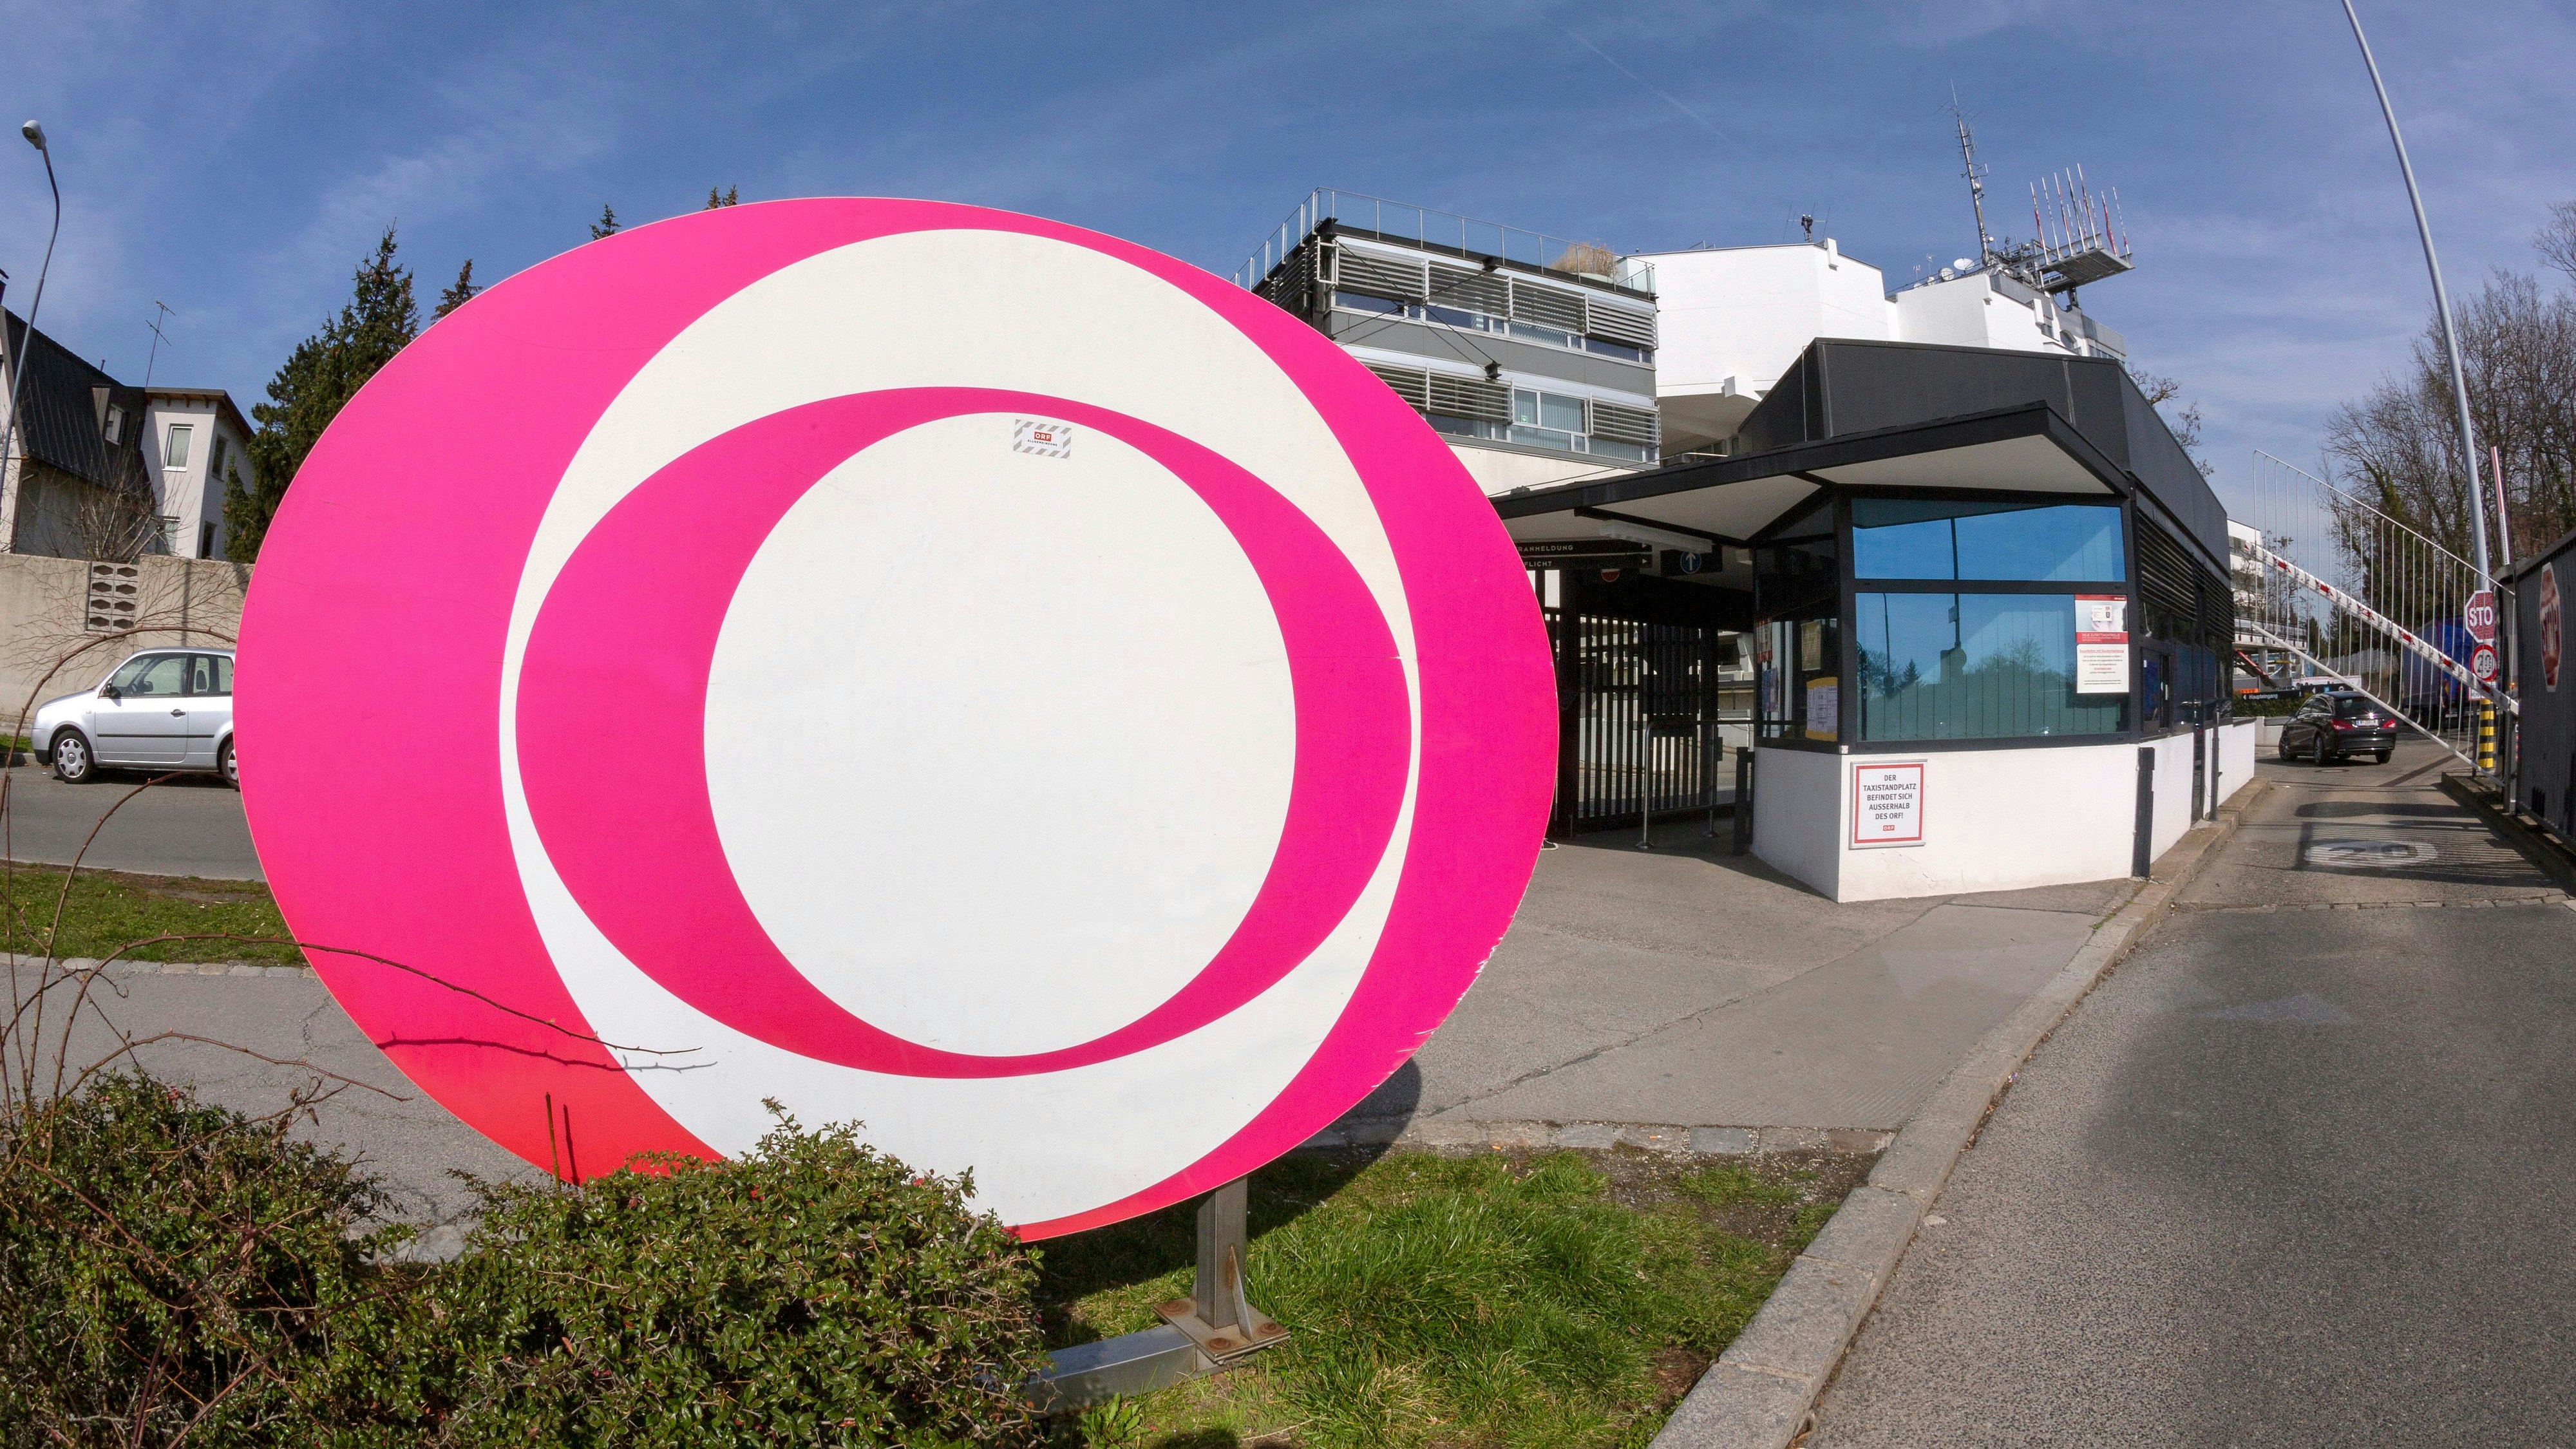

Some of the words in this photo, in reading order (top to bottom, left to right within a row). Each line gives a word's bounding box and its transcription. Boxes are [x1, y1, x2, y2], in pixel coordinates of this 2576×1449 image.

[2469, 606, 2493, 627] STO
[1863, 783, 1917, 791] TAXISTANDPLATZ
[1869, 802, 1910, 811] AUSSERHALB
